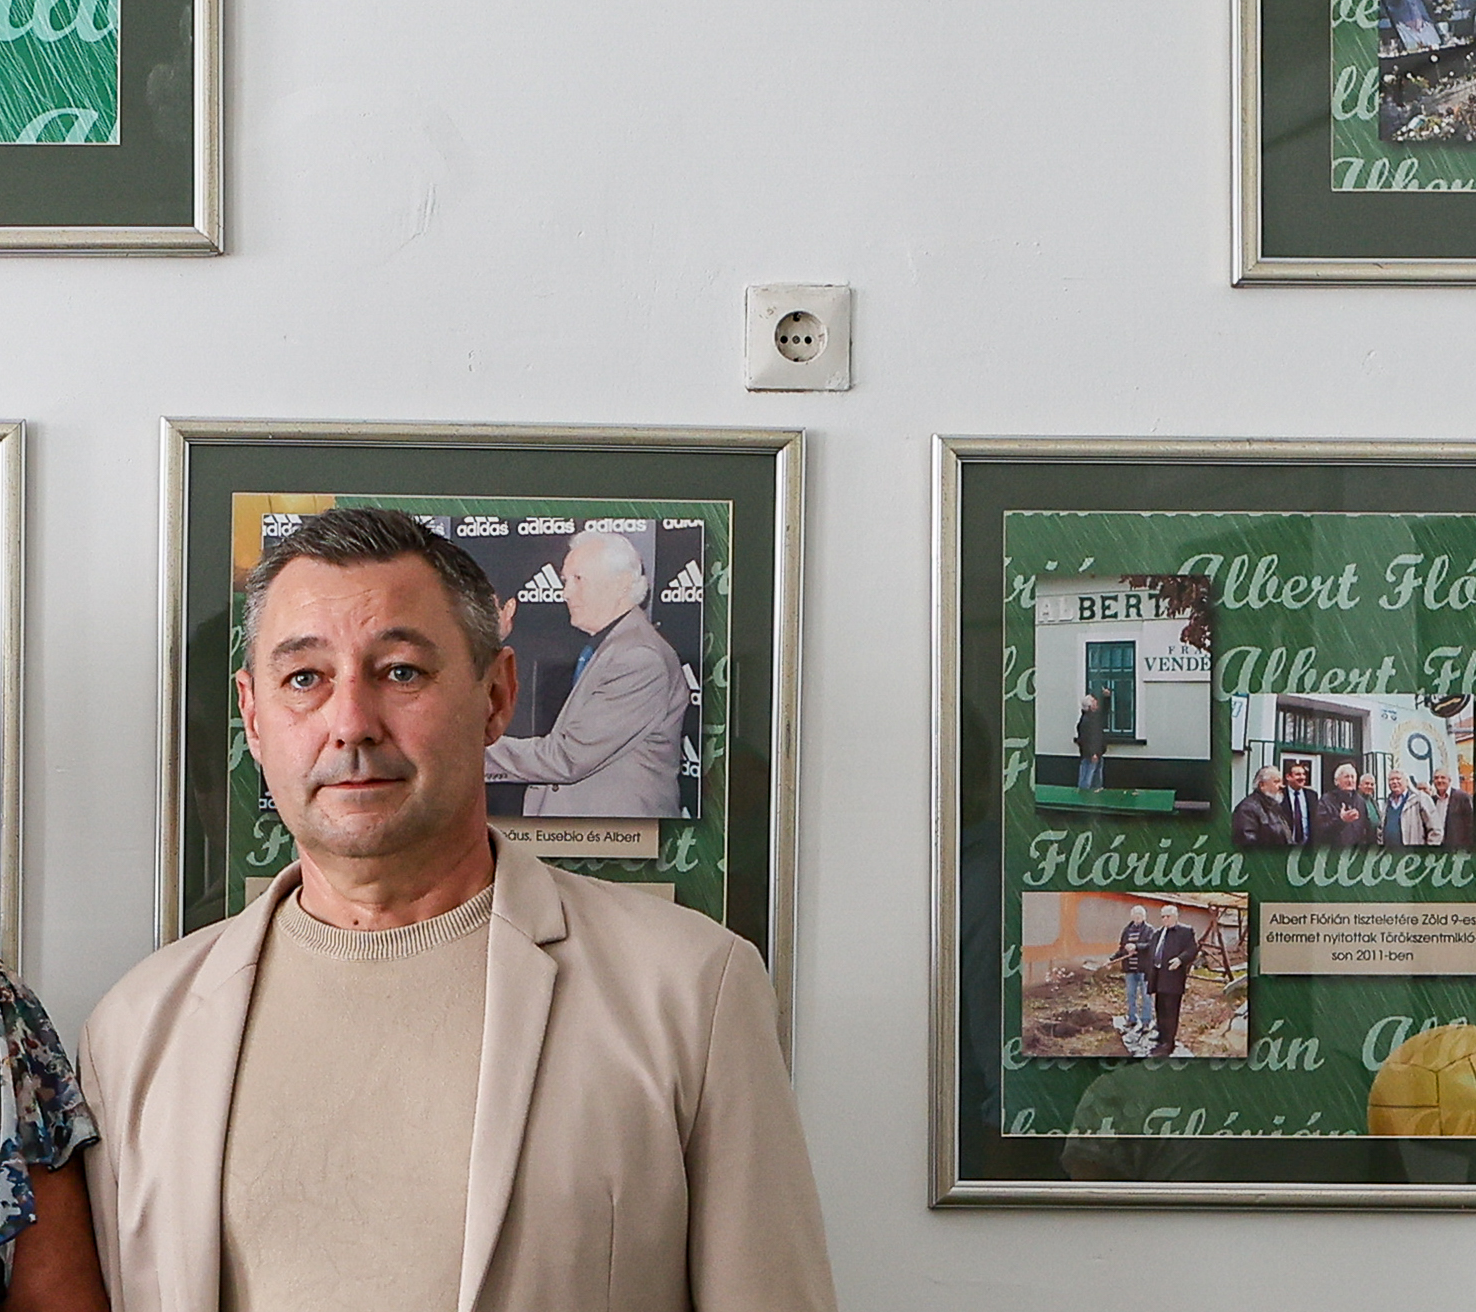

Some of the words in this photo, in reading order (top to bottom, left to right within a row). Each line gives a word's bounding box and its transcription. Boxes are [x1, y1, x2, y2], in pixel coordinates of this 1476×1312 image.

[457, 522, 509, 536] adidas
[518, 520, 575, 535] adidas
[1407, 732, 1433, 786] 9
[536, 829, 584, 842] Eusebio
[586, 830, 600, 842] és
[603, 831, 641, 843] Albert
[1023, 829, 1247, 888] Flórián
[1269, 913, 1307, 925] Albert
[1310, 913, 1350, 925] Flórián
[1353, 913, 1418, 925] tiszteletére
[1421, 913, 1448, 925] Zöld
[1450, 913, 1476, 925] 9-es
[1266, 931, 1320, 943] éttermet
[1323, 931, 1377, 945] nyitottak
[1331, 952, 1354, 962] son
[1356, 950, 1415, 962] 2011-ben
